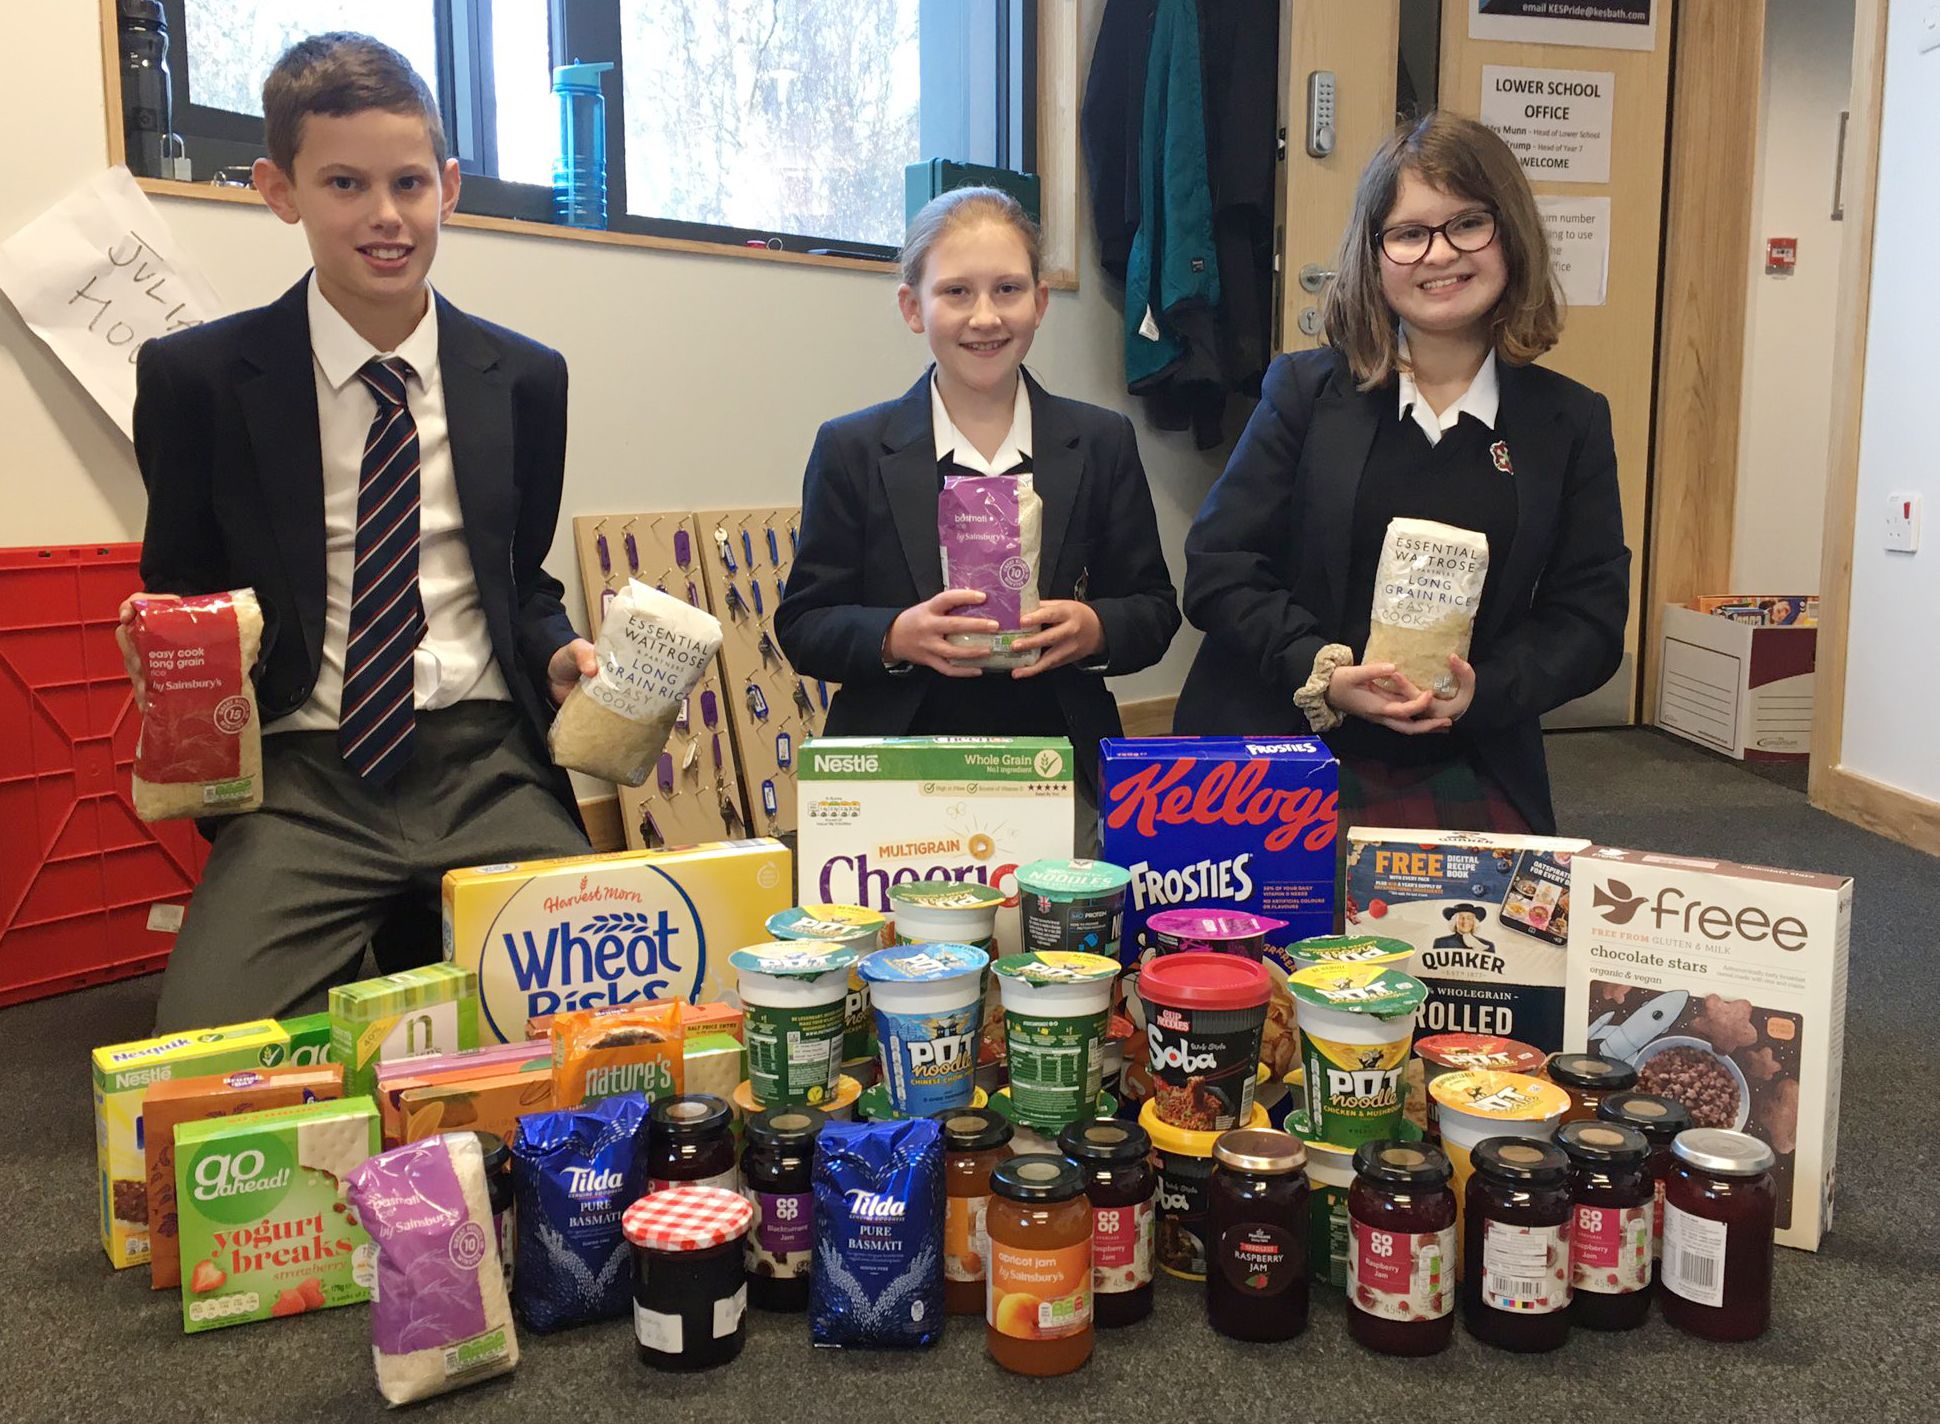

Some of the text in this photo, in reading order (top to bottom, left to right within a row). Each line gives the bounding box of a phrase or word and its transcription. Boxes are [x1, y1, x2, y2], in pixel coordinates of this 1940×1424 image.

[1522, 2, 1646, 21] email KESPride@kesbath.com
[1495, 78, 1601, 98] LOWER SCHOOL
[1524, 104, 1570, 120] OFFICE
[1502, 125, 1527, 135] Munn
[1533, 127, 1550, 136] Head
[1550, 128, 1558, 137] of
[1559, 129, 1579, 138] Lower
[1579, 130, 1601, 139] School
[1537, 144, 1555, 152] Head
[1555, 144, 1563, 152] of
[1563, 145, 1578, 153] Year
[1520, 157, 1570, 169] WELCOME
[1559, 213, 1596, 224] number
[1565, 231, 1593, 240] to use
[954, 513, 988, 523] basmati
[956, 533, 965, 542] by
[1396, 537, 1478, 560] ESSENTIAL
[1395, 550, 1477, 573] WATROSE
[1011, 567, 1021, 578] 10
[1408, 575, 1452, 591] LONG
[1385, 584, 1472, 608] GRAIN RICE
[1396, 601, 1434, 614] EASY
[1382, 609, 1423, 625] COOK
[628, 614, 709, 655] ESSENTIAL
[148, 647, 205, 660] easy cook
[624, 627, 705, 669] WAITROSE
[149, 657, 205, 670] long grain
[632, 659, 680, 685] LONG
[606, 661, 655, 692] GRAIN
[152, 678, 223, 693] by Sainsbury's
[592, 685, 636, 715] COOK
[230, 709, 242, 720] 15
[1245, 742, 1317, 756] FROSTIES
[964, 754, 1032, 766] Whole Grain
[879, 839, 961, 858] MULTIGRAIN
[1375, 850, 1444, 877] FREE
[1446, 854, 1480, 864] DIGITAL
[1446, 862, 1477, 872] RECIPE
[1129, 853, 1253, 911] FROSTIES
[1446, 870, 1469, 879] BOOK
[1529, 866, 1564, 884] FOR EVERY
[544, 886, 643, 913] Harvest Morn
[1650, 887, 1809, 952] freee
[1591, 926, 1617, 938] FREE
[1619, 931, 1650, 943] FROM
[1651, 936, 1692, 950] GLUTEN
[1704, 943, 1731, 955] MILK
[503, 910, 682, 992] Wheat
[1589, 945, 1708, 974] chocolate stars
[1421, 951, 1506, 975] QUAKER
[1589, 965, 1662, 985] organic & vegan
[1437, 987, 1512, 1000] WHOLEGRAIN
[1162, 1009, 1182, 1020] CUP
[1413, 1000, 1514, 1036] ROLLED
[112, 1039, 192, 1062] Nesquik
[907, 1029, 976, 1069] POT
[1147, 1023, 1218, 1074] Soba
[584, 1054, 672, 1097] nature's
[1326, 1067, 1404, 1096] POT
[1330, 1086, 1399, 1109] noodle
[1323, 1105, 1357, 1117] CHICKEN
[193, 1149, 266, 1201] go
[219, 1167, 291, 1197] ahead!
[560, 1166, 624, 1194] Tilda
[580, 1199, 612, 1213] PURE
[845, 1188, 906, 1217] Tilda
[569, 1211, 623, 1227] BASMATI
[211, 1213, 324, 1259] yogurt
[379, 1224, 394, 1240] by
[767, 1223, 809, 1233] Blackcurrant
[859, 1225, 893, 1237] PURE
[464, 1238, 476, 1252] 10
[780, 1233, 795, 1242] Jam
[848, 1238, 903, 1251] BASMATI
[231, 1235, 353, 1275] breaks
[998, 1252, 1057, 1269] apricot jam
[1101, 1253, 1116, 1261] Jam
[1234, 1250, 1285, 1263] RASPBERRY
[1582, 1251, 1598, 1261] Jam
[272, 1260, 348, 1282] strawberry
[1249, 1263, 1268, 1273] JAM
[1365, 1257, 1400, 1274] Raspberry
[999, 1266, 1065, 1283] by Sainsbury's
[1373, 1270, 1389, 1280] Jam
